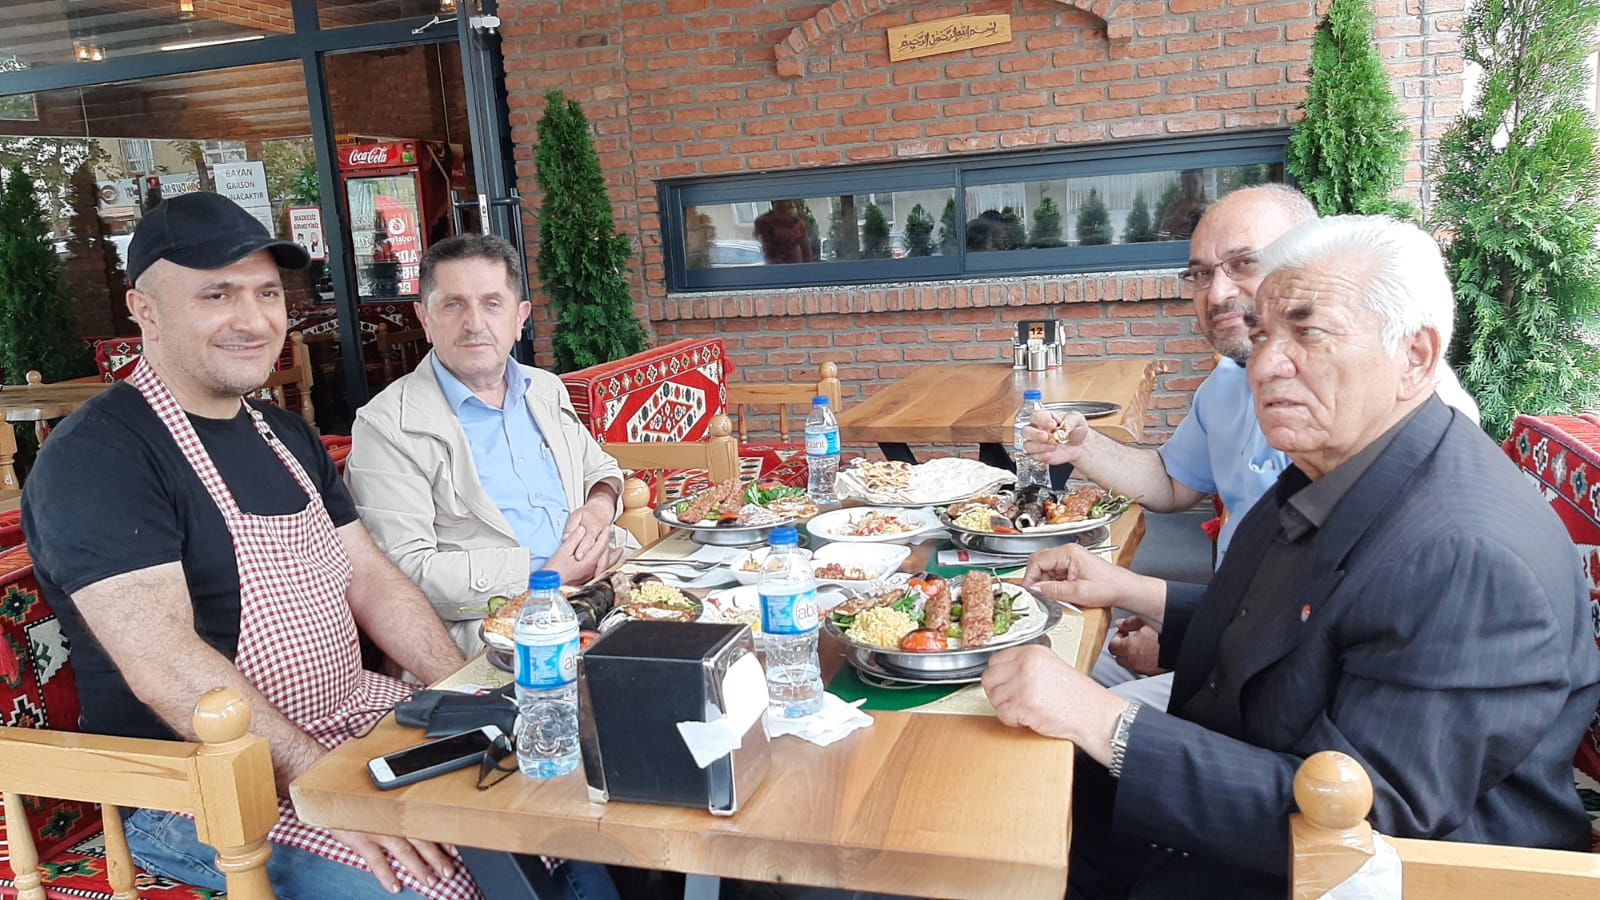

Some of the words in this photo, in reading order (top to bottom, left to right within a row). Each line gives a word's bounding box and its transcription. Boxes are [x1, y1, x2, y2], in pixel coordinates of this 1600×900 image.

[349, 147, 388, 166] Coca-Cola
[226, 168, 253, 178] BAYAN
[226, 181, 255, 190] GARSON
[1031, 326, 1043, 336] 12
